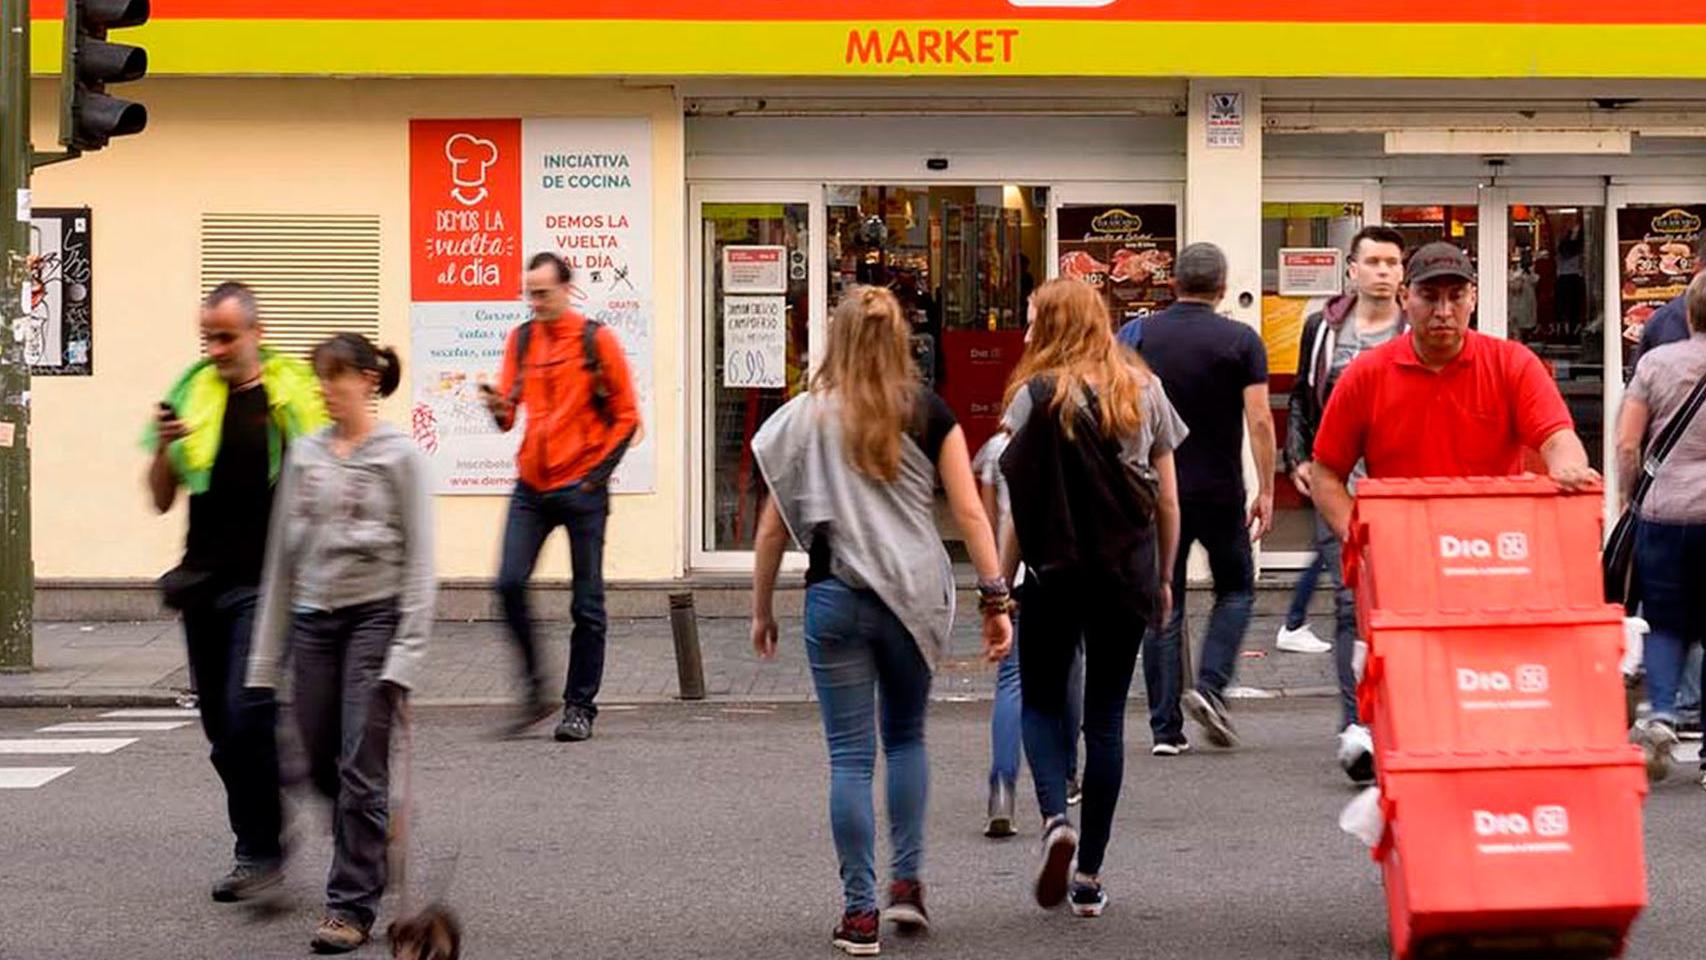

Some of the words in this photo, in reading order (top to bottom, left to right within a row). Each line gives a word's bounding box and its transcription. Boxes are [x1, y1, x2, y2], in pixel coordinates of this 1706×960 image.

[845, 29, 1019, 64] MARKET
[544, 155, 629, 168] INICIATIVA
[543, 175, 564, 188] DE
[568, 175, 631, 188] COCINA
[436, 210, 480, 231] DEMOS
[485, 210, 504, 231] LA
[546, 215, 603, 228] DEMOS
[608, 215, 629, 228] LA
[435, 232, 506, 256] vuelta
[556, 235, 618, 248] VUELTA
[438, 262, 457, 284] al
[475, 309, 520, 321] Cursos
